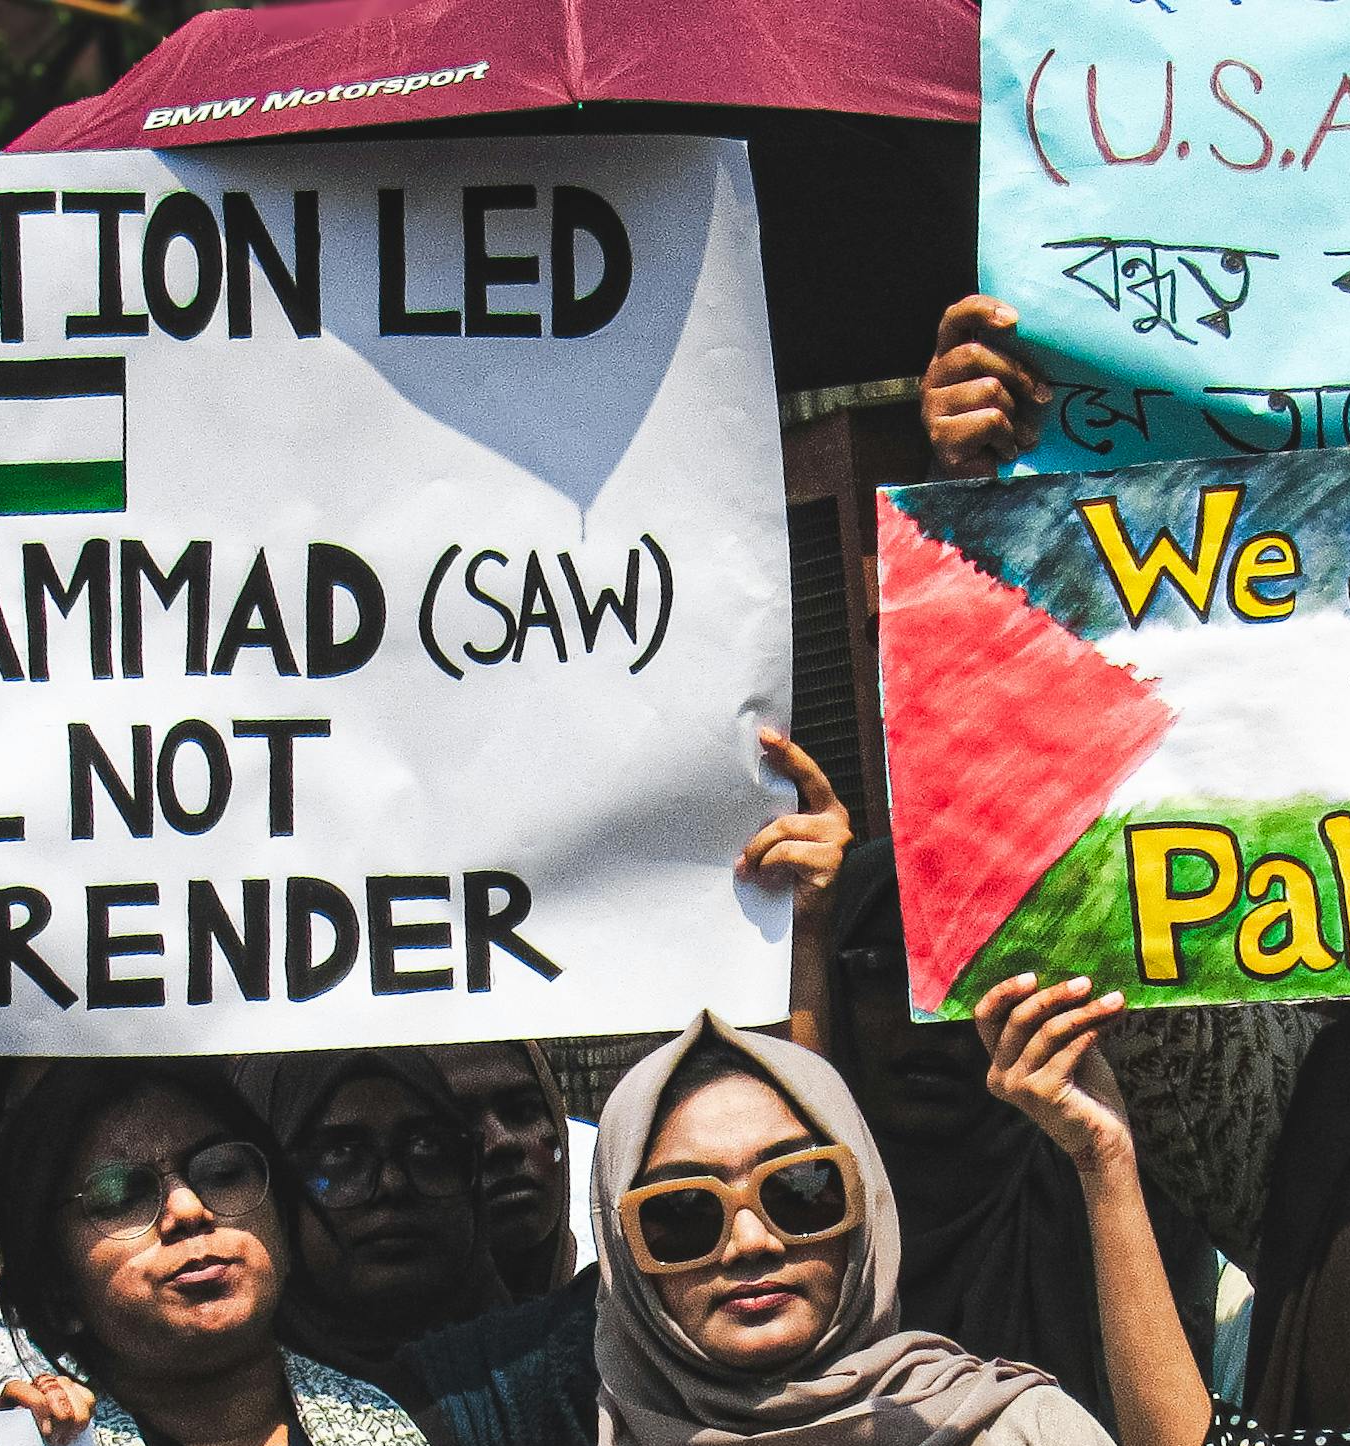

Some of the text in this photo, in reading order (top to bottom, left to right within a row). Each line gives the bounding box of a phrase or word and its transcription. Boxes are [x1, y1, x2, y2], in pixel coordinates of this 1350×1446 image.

[143, 61, 490, 131] BMW Motorsport
[378, 185, 633, 339] LED
[418, 533, 673, 681] (SAW)
[1077, 484, 1302, 628] We
[69, 718, 331, 840] NOT
